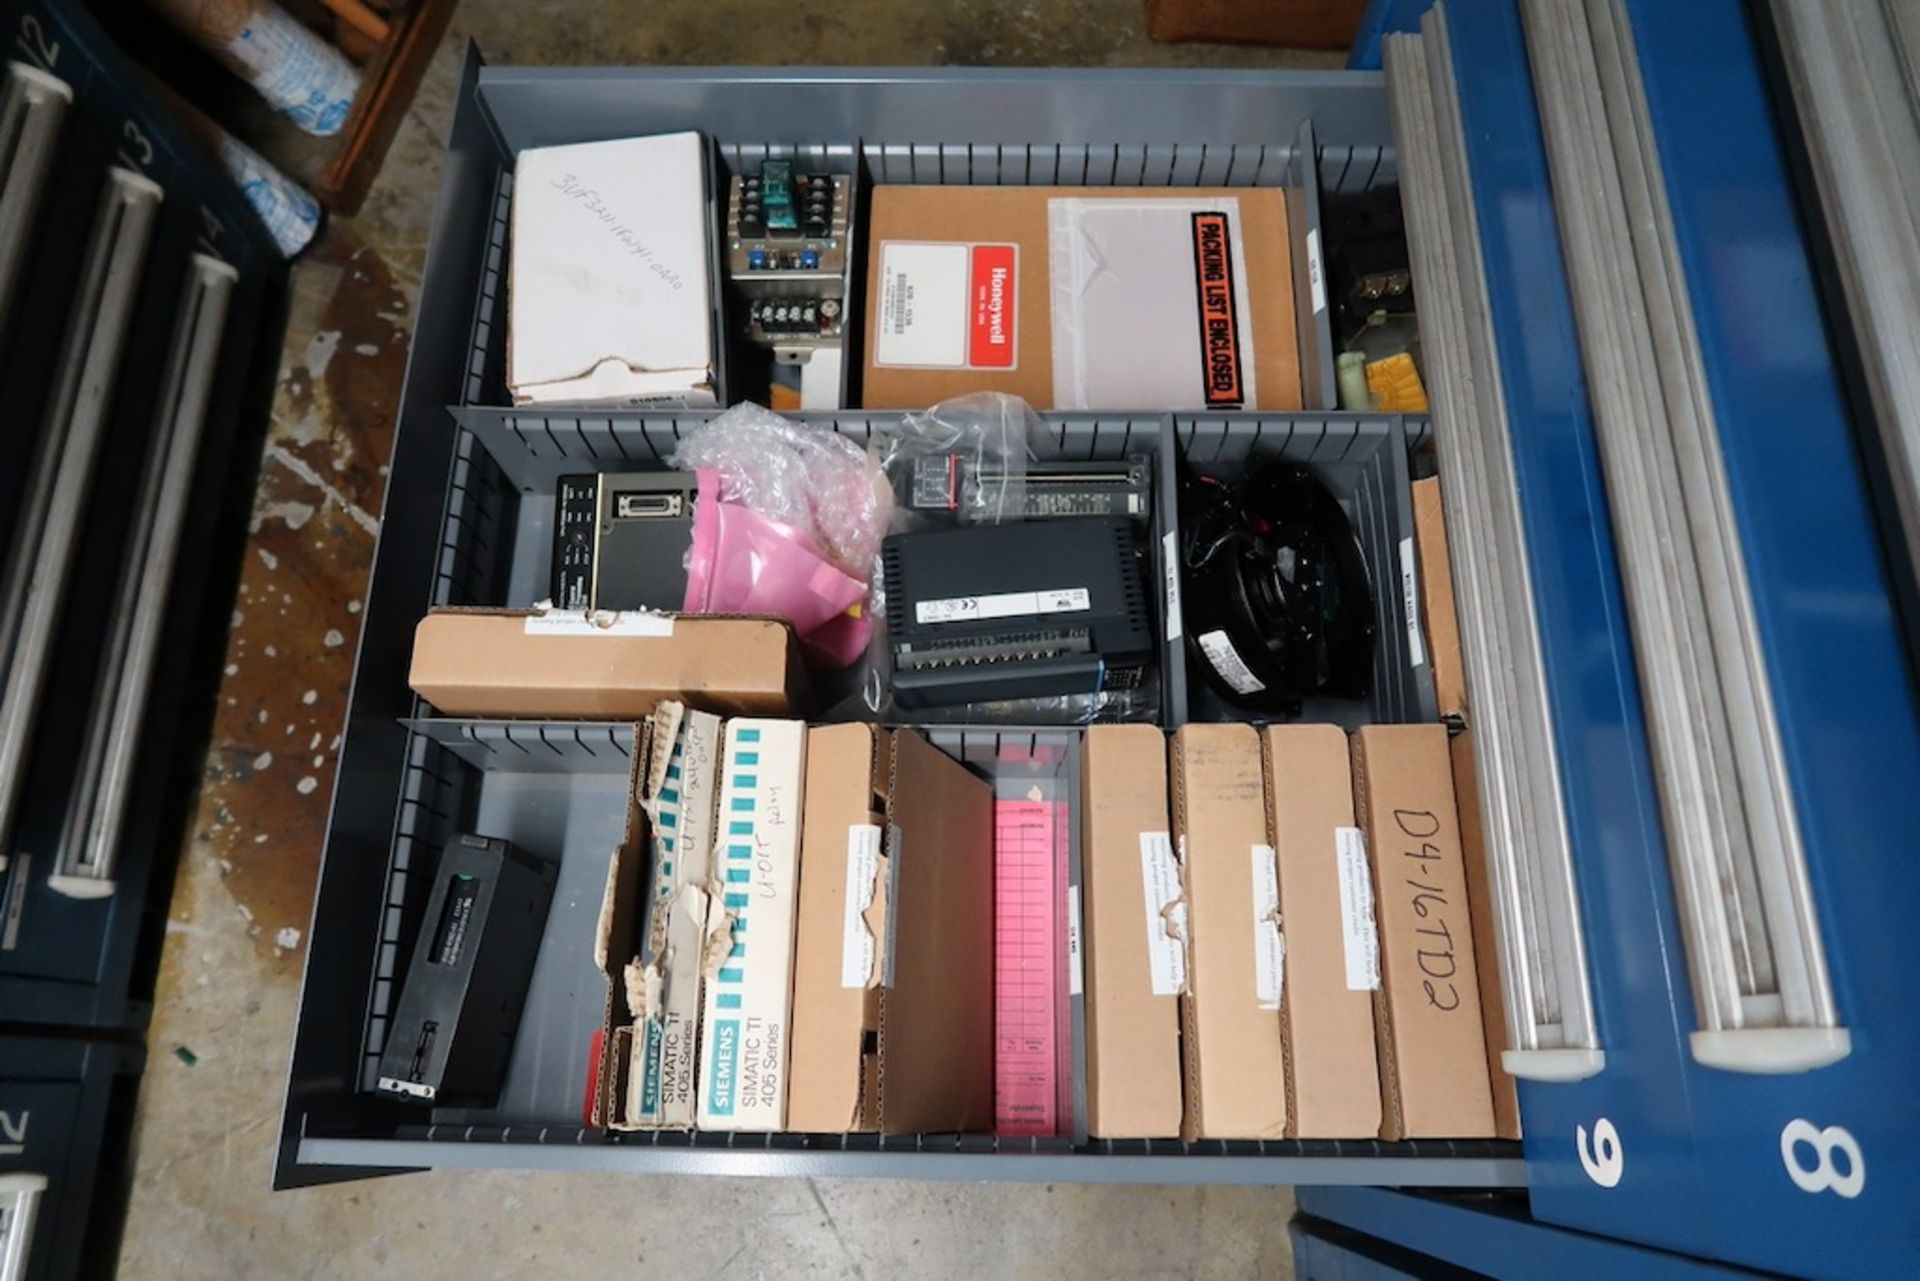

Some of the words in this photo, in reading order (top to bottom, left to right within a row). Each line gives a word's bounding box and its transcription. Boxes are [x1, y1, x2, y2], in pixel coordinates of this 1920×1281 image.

[1201, 222, 1225, 283] PACKING
[988, 267, 1007, 344] Honeywell
[1206, 285, 1228, 316] LIST
[1209, 318, 1234, 393] ENCLOSED
[667, 1012, 680, 1026] TI
[678, 1019, 693, 1067] Series
[746, 1016, 762, 1032] TI
[661, 1033, 679, 1104] SIMATIC
[714, 1026, 734, 1108] SIEMENS
[741, 1037, 760, 1108] SIMATIC
[762, 1023, 779, 1070] Series
[677, 1070, 691, 1104] 405
[761, 1073, 777, 1108] 405
[1780, 1117, 1866, 1199] 8
